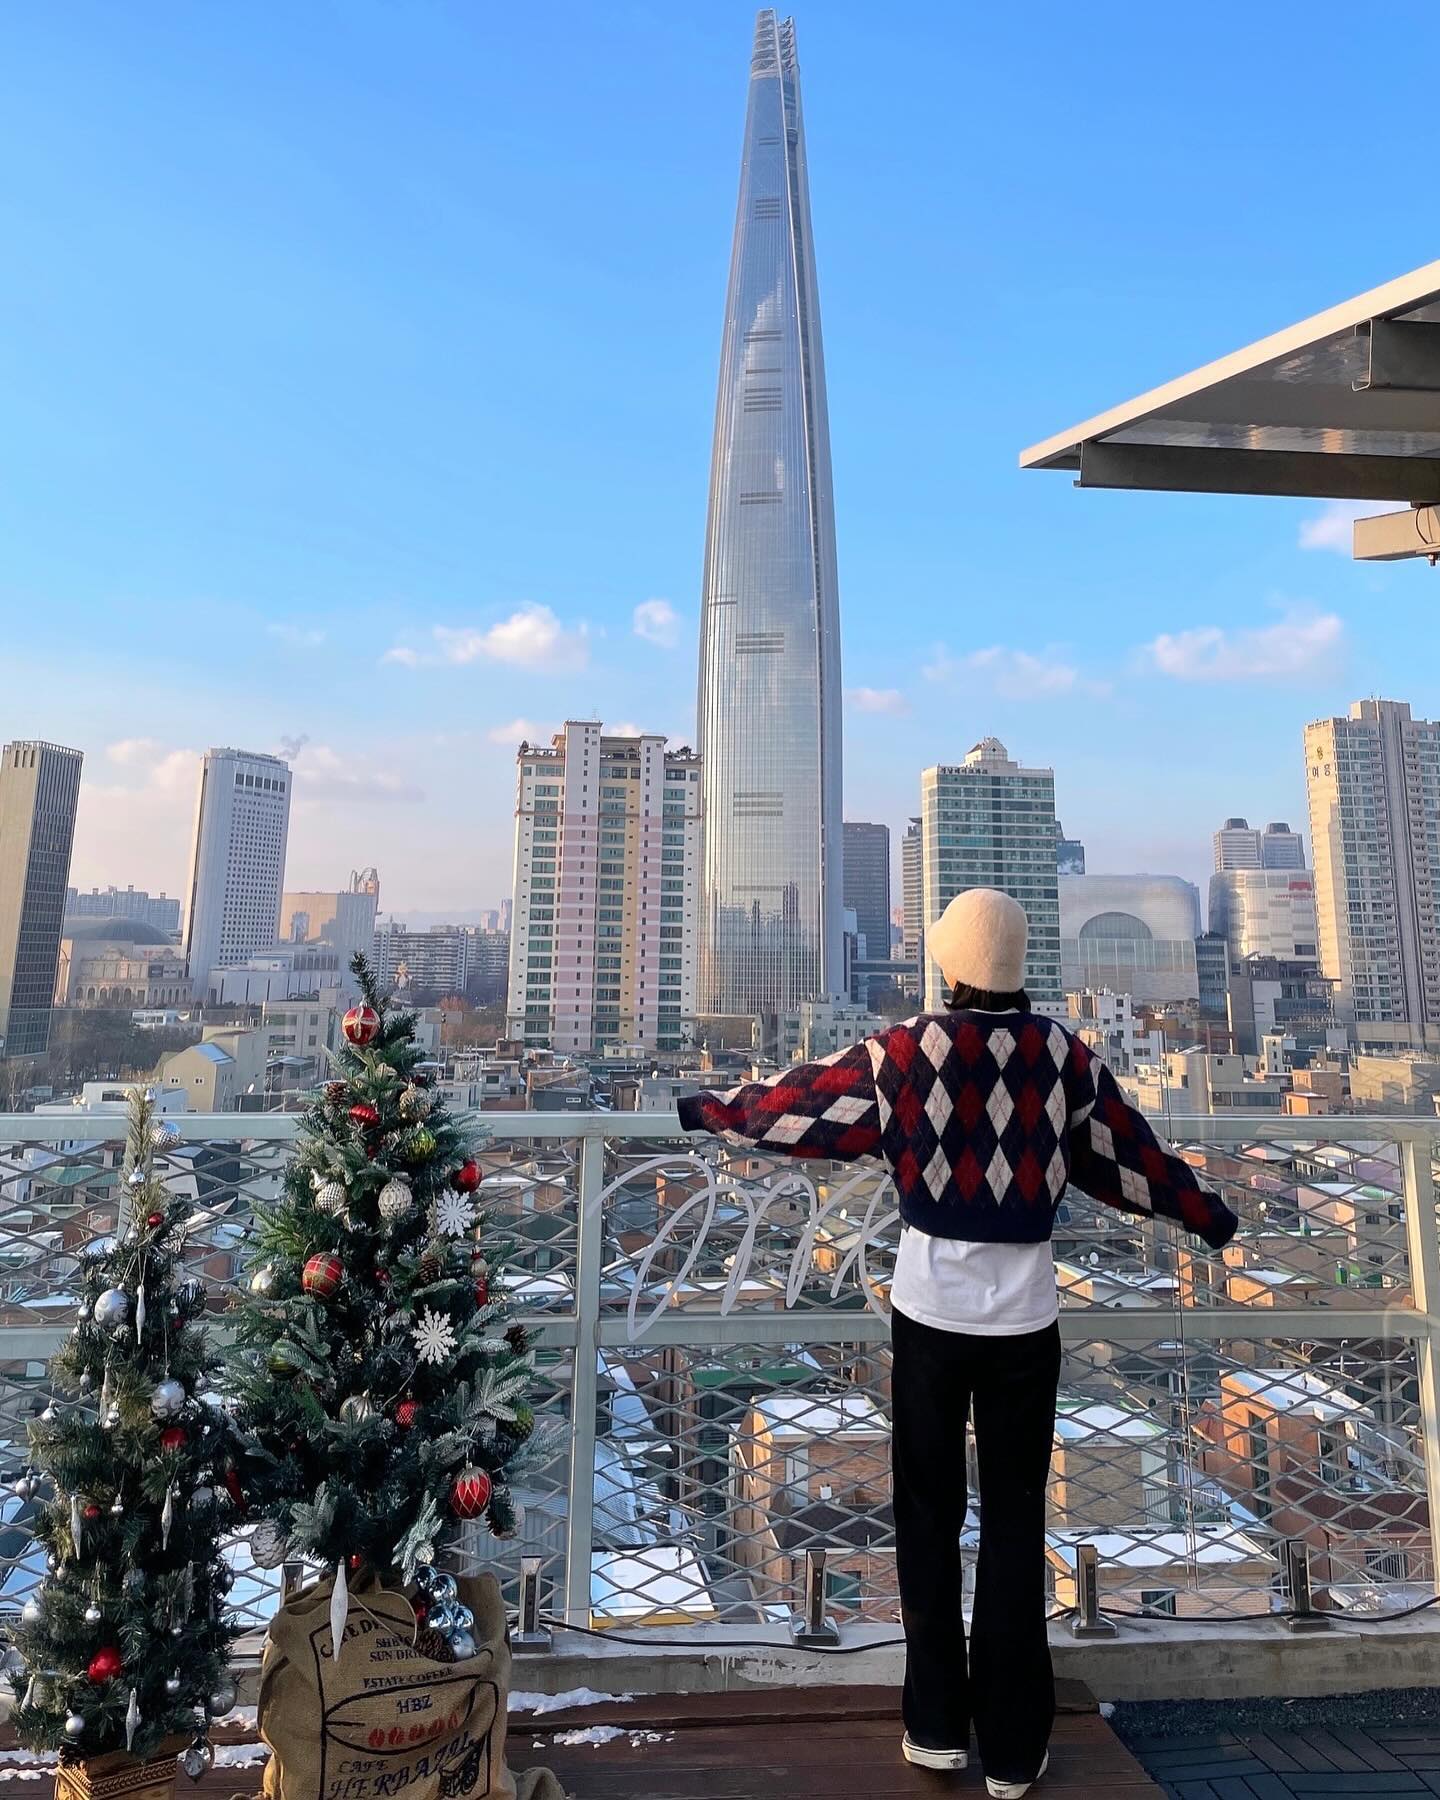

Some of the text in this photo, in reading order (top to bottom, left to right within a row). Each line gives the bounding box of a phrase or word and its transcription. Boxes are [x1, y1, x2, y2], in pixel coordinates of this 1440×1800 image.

[363, 1666, 453, 1689] ESTATE COFFEE
[396, 1694, 433, 1714] HBZ
